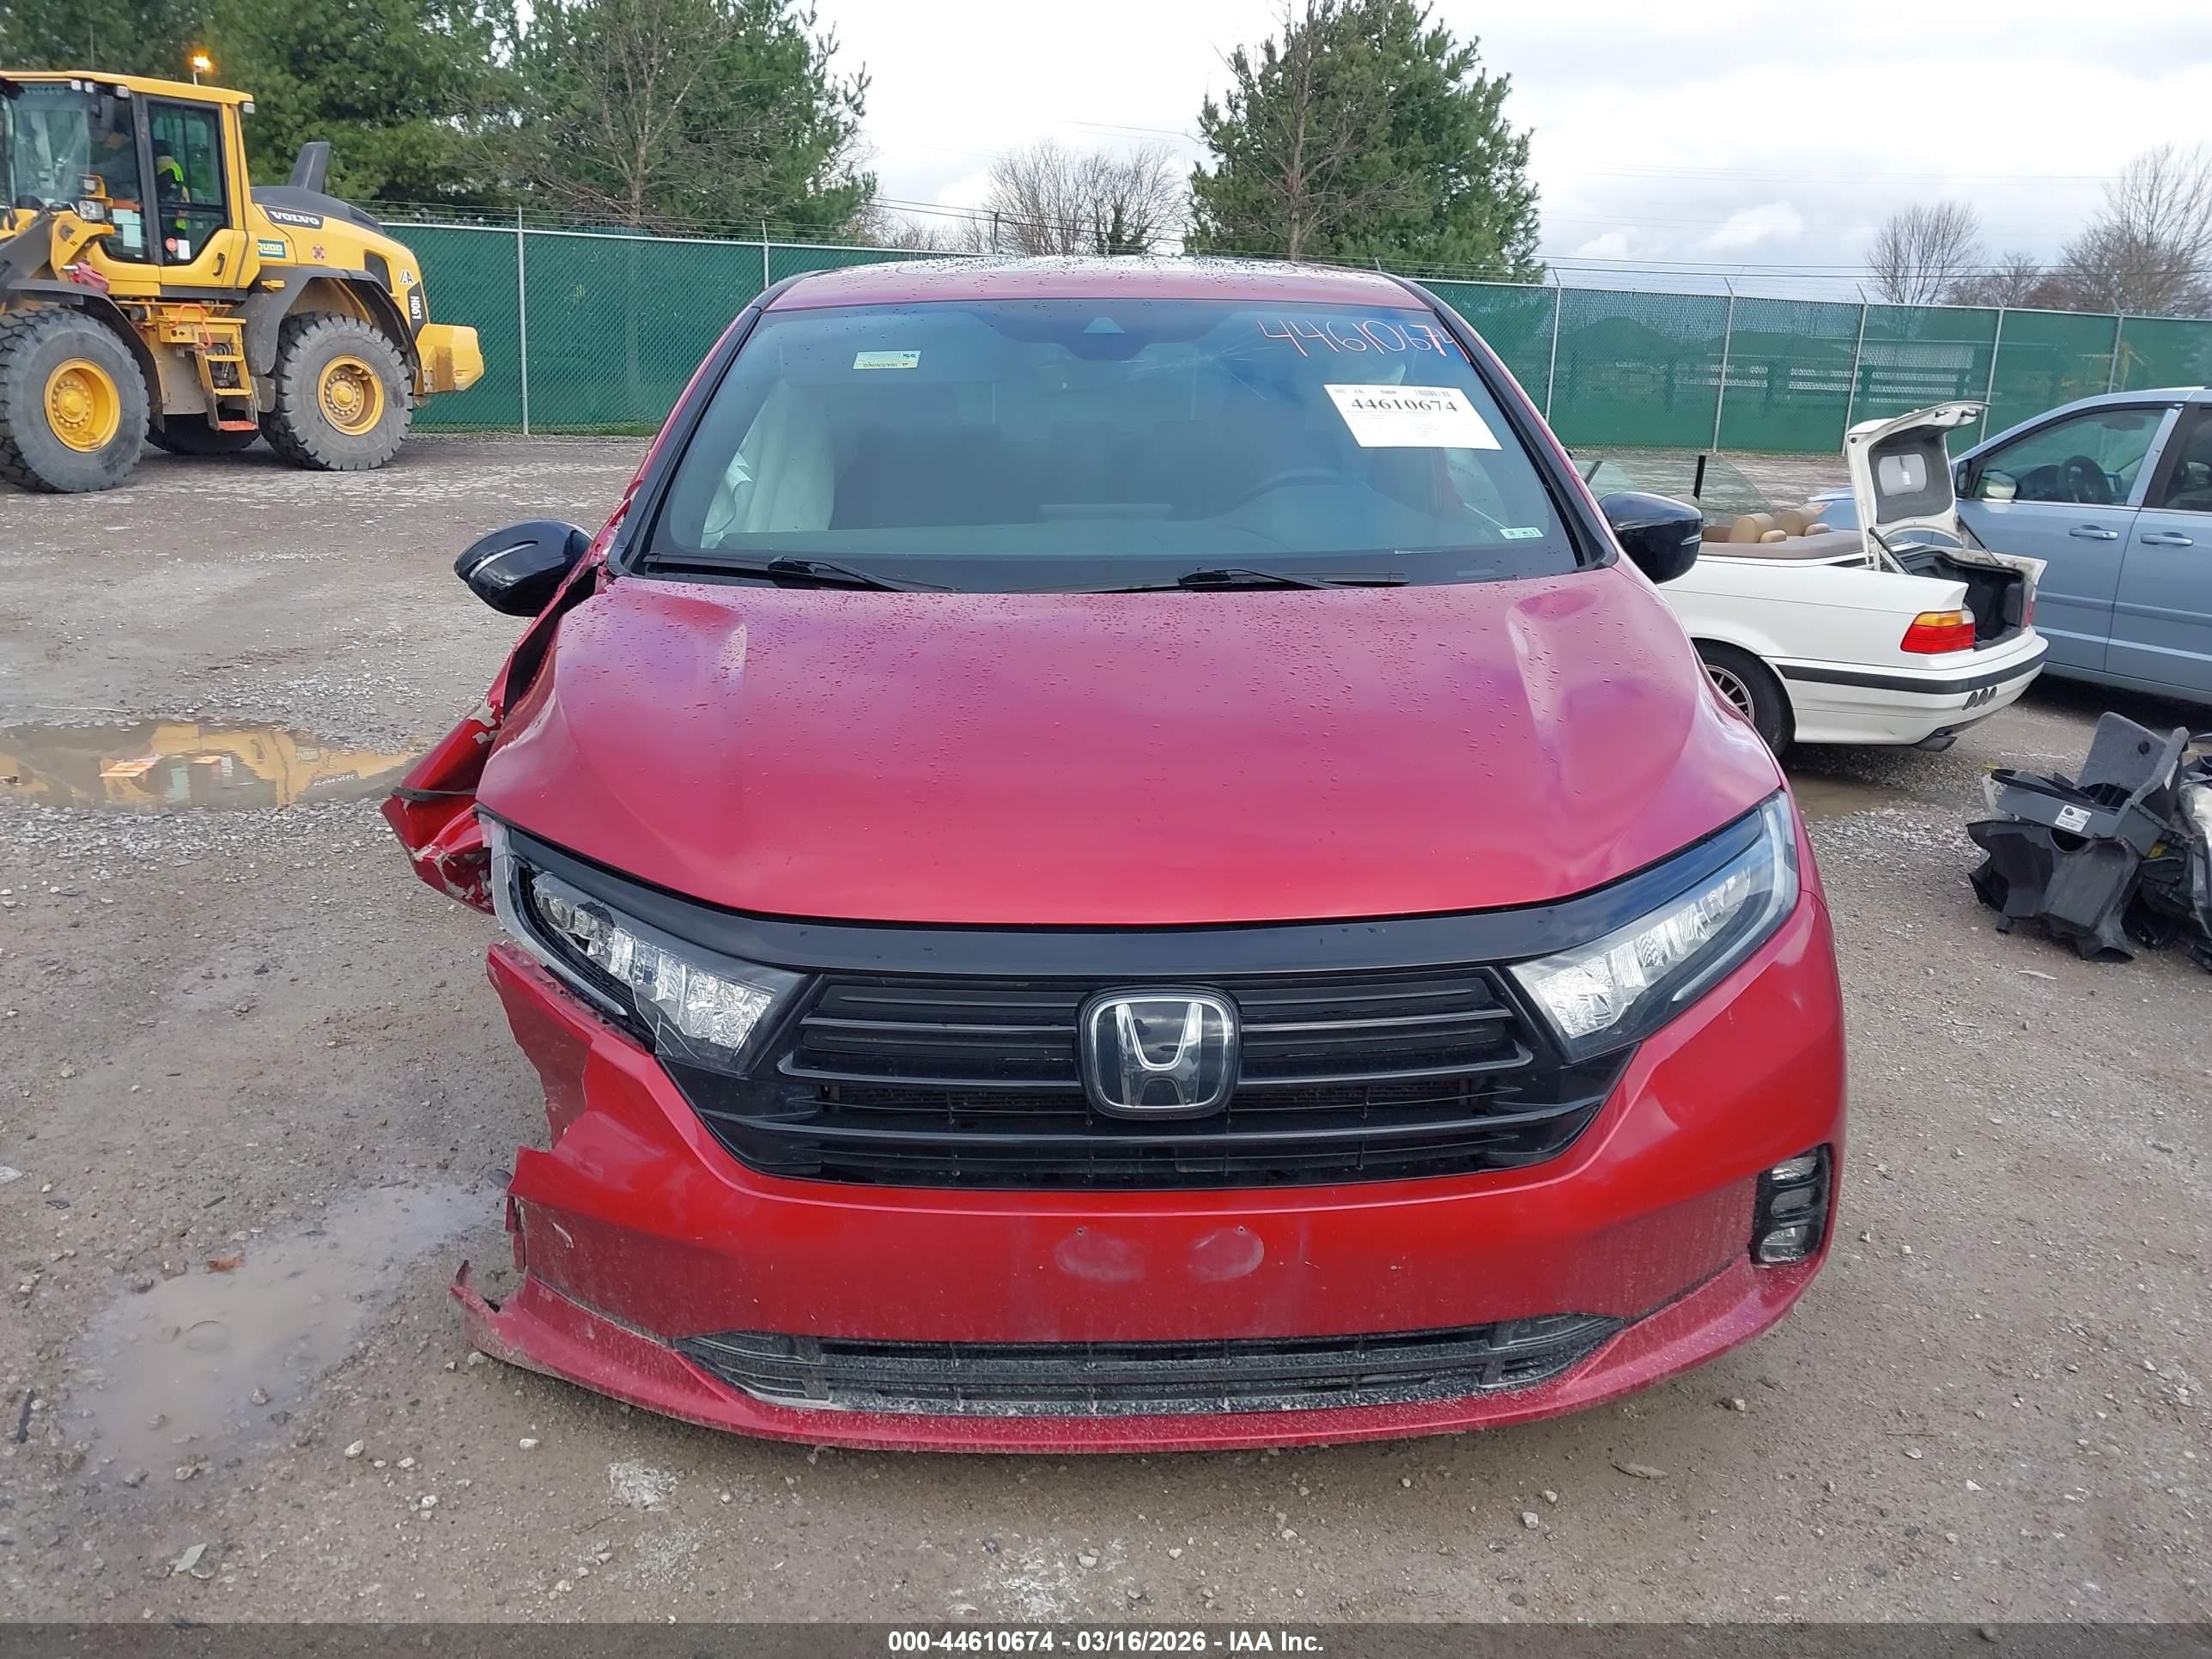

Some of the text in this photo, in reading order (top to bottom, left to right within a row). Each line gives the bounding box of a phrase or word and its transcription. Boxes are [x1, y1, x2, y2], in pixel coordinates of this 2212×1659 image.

[269, 210, 320, 225] VOLVO
[410, 295, 422, 319] L90H
[1256, 320, 1471, 364] 44610674
[1351, 398, 1458, 411] 44610674
